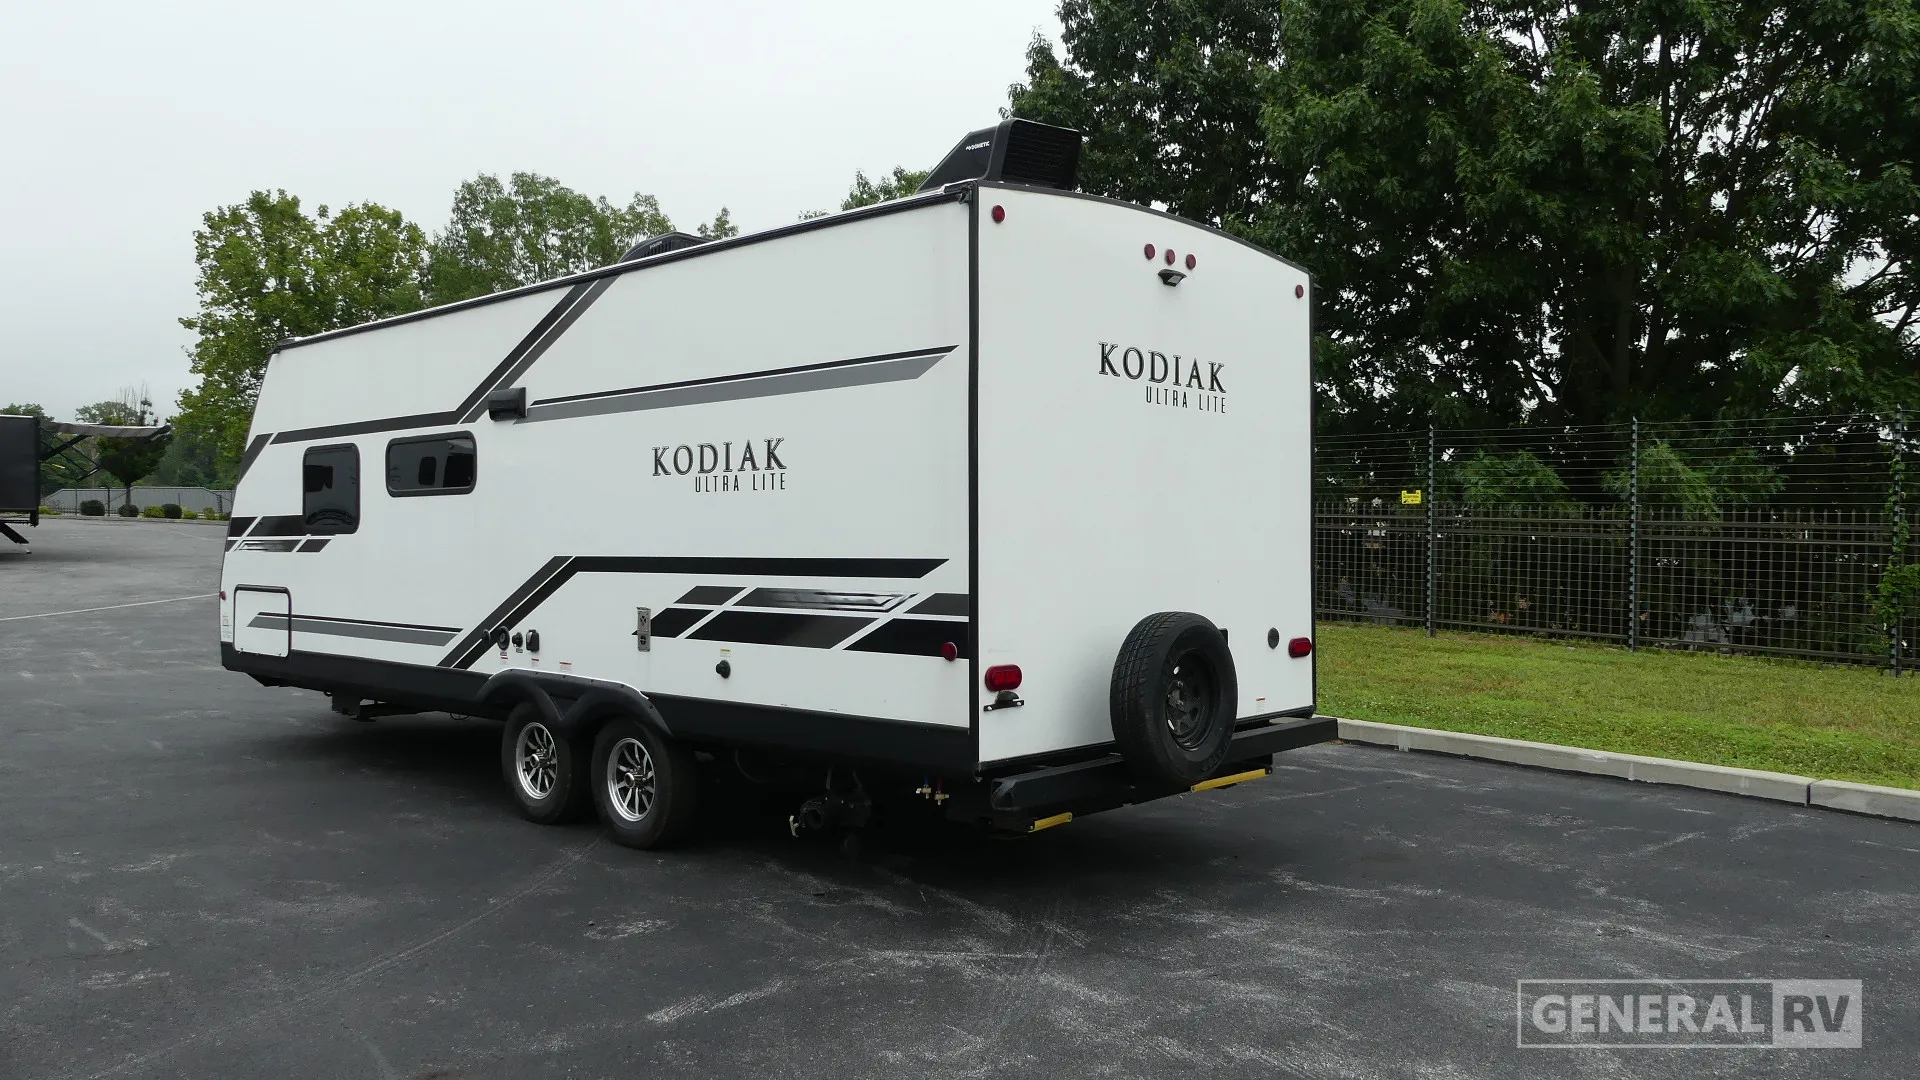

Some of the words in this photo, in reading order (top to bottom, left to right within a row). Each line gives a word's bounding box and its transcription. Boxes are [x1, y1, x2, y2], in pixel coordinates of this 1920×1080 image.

[1098, 341, 1226, 393] KODIAK
[1145, 385, 1188, 408] ULTRA
[1198, 393, 1226, 413] LITE
[651, 437, 787, 476] KODIAK
[695, 474, 740, 492] ULTRA
[752, 472, 786, 491] LITE
